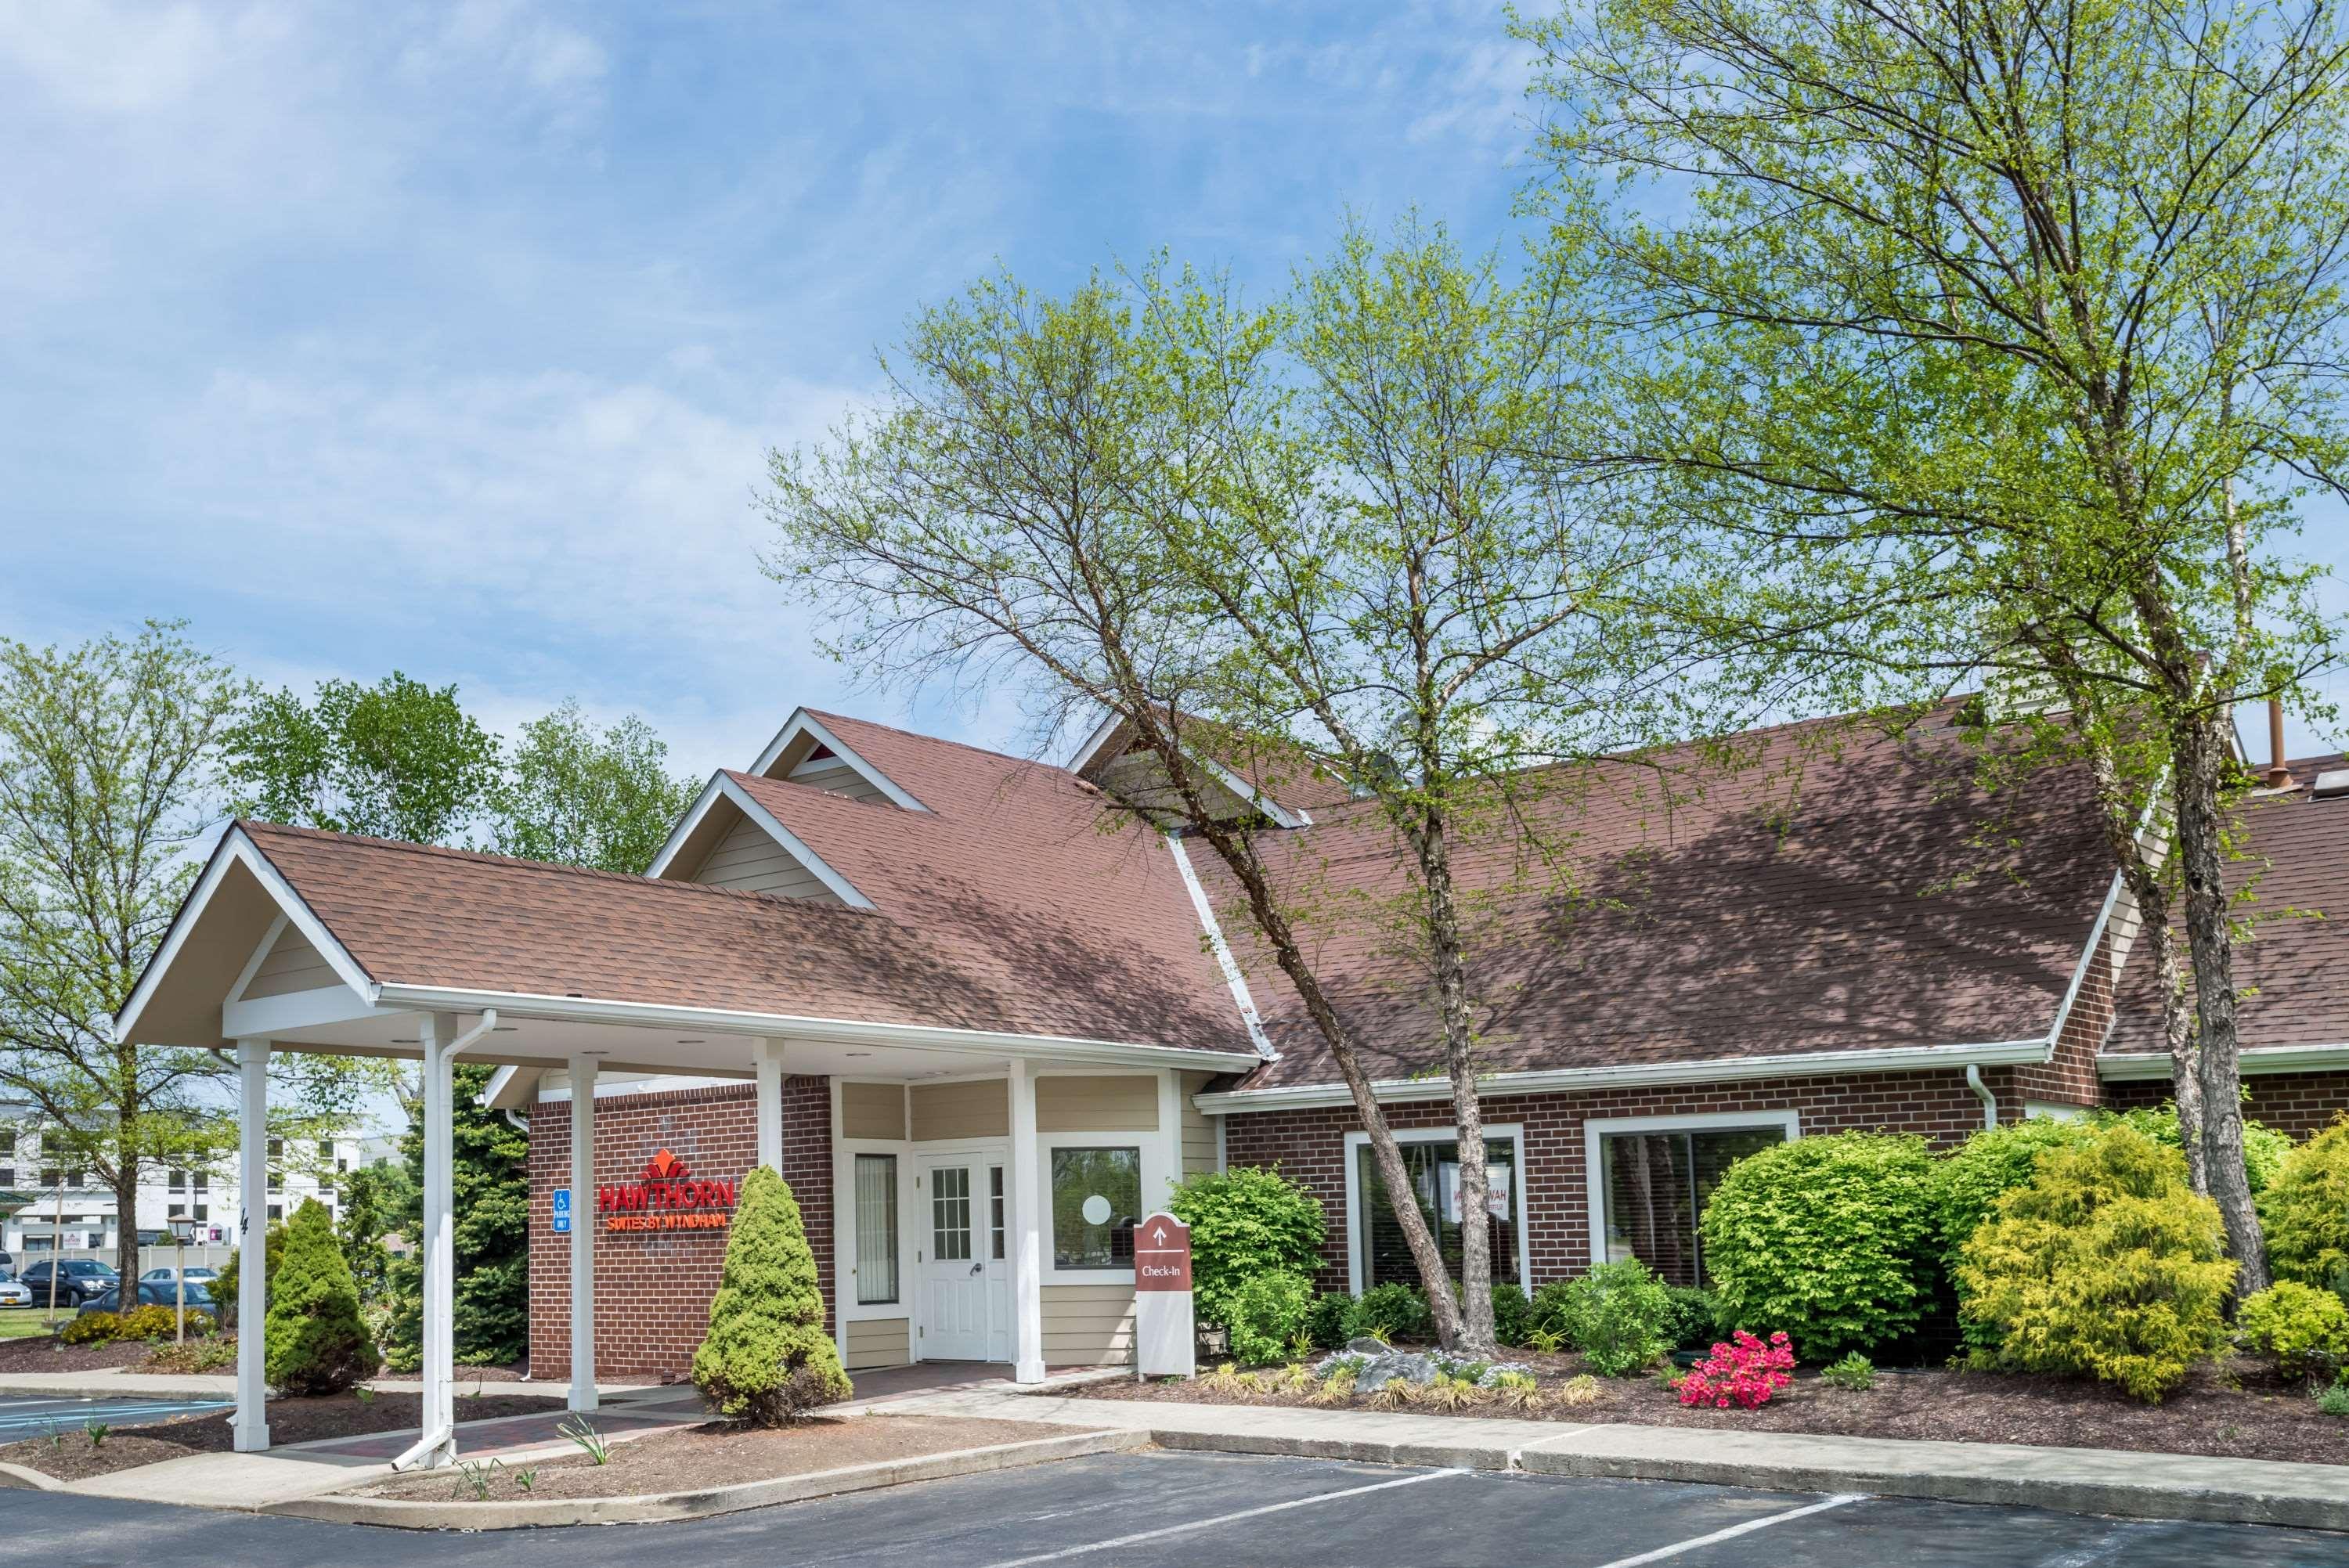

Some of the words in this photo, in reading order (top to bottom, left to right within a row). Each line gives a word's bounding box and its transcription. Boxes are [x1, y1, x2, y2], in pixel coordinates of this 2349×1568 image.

[600, 1177, 734, 1212] HAWTHORN
[608, 1216, 646, 1231] SUITES
[648, 1216, 662, 1230] BY
[666, 1213, 727, 1229] WYNDHAM
[1142, 1265, 1181, 1277] Check-In
